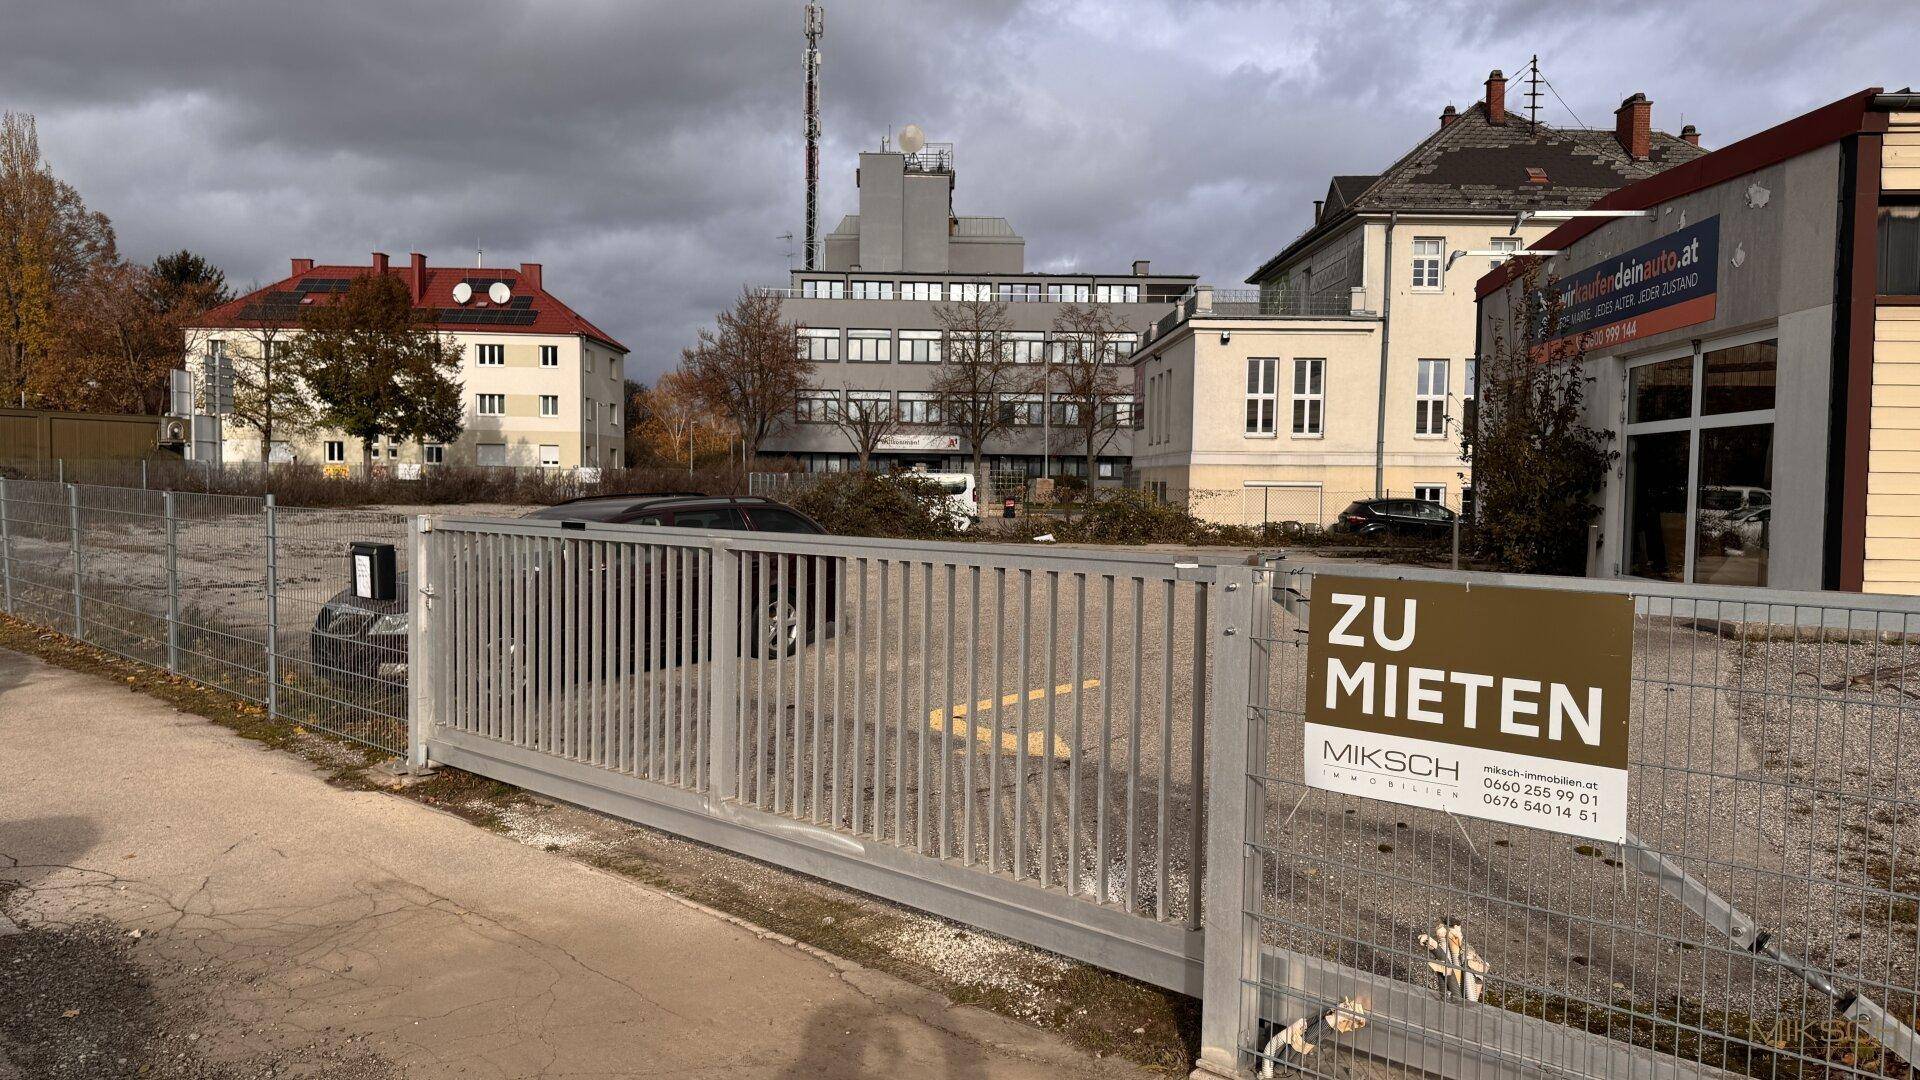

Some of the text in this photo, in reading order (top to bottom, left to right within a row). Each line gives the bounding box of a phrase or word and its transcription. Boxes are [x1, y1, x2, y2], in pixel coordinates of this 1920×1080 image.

[1594, 302, 1614, 318] JEDES
[1614, 293, 1636, 310] ALTER.
[1637, 285, 1660, 304] JEDER
[1661, 272, 1699, 296] ZUSTAND
[1605, 325, 1620, 344] 999
[1621, 320, 1637, 339] 144
[1328, 592, 1417, 652] ZU
[1325, 657, 1603, 747] MIETEN
[1323, 740, 1460, 781] MIKSCH
[1323, 769, 1459, 799] IMMOBILIEN
[1483, 765, 1599, 791] miksch-immobilien.at
[1483, 777, 1598, 806] 0660 255 99 01
[1483, 793, 1597, 823] 0676 540 14 51
